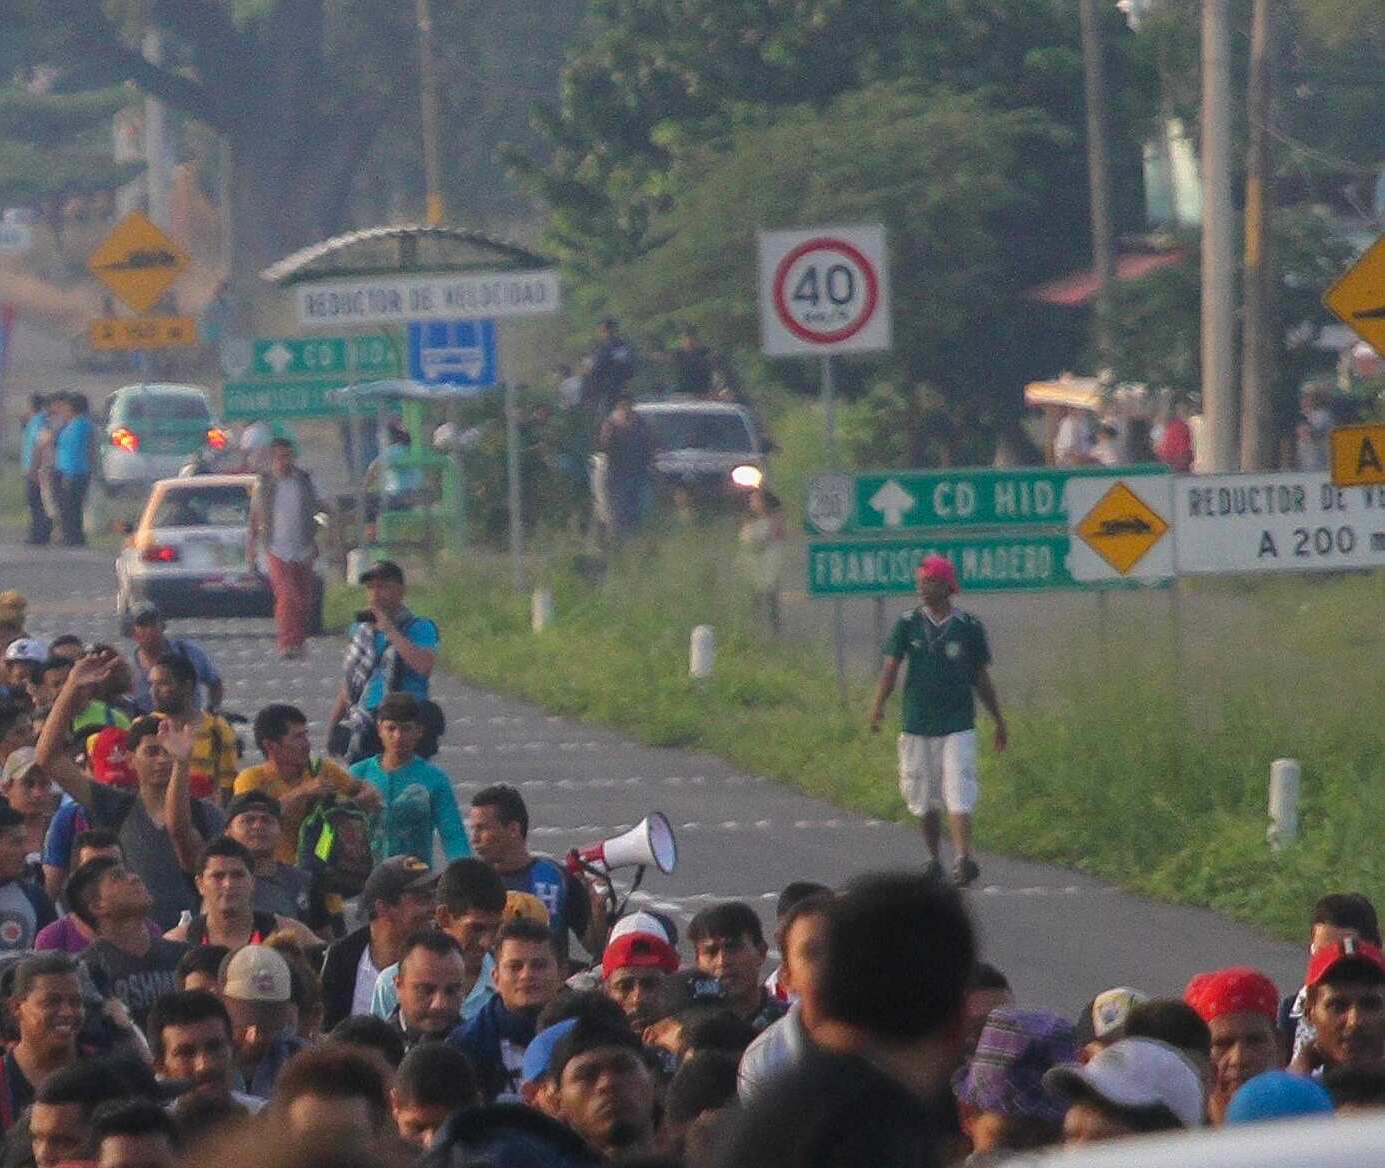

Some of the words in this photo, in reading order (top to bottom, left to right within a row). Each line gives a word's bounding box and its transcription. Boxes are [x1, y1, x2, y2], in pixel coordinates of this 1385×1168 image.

[304, 287, 403, 318] REDUCTOR
[410, 286, 433, 310] DE
[444, 282, 547, 307] VELOCIDAD
[792, 264, 854, 306] 40
[1356, 436, 1384, 475] A
[933, 480, 976, 516] CD
[1188, 484, 1306, 516] REDUCTOR
[1258, 530, 1278, 557] A
[1293, 526, 1356, 557] 200
[962, 545, 1052, 579] MADERO
